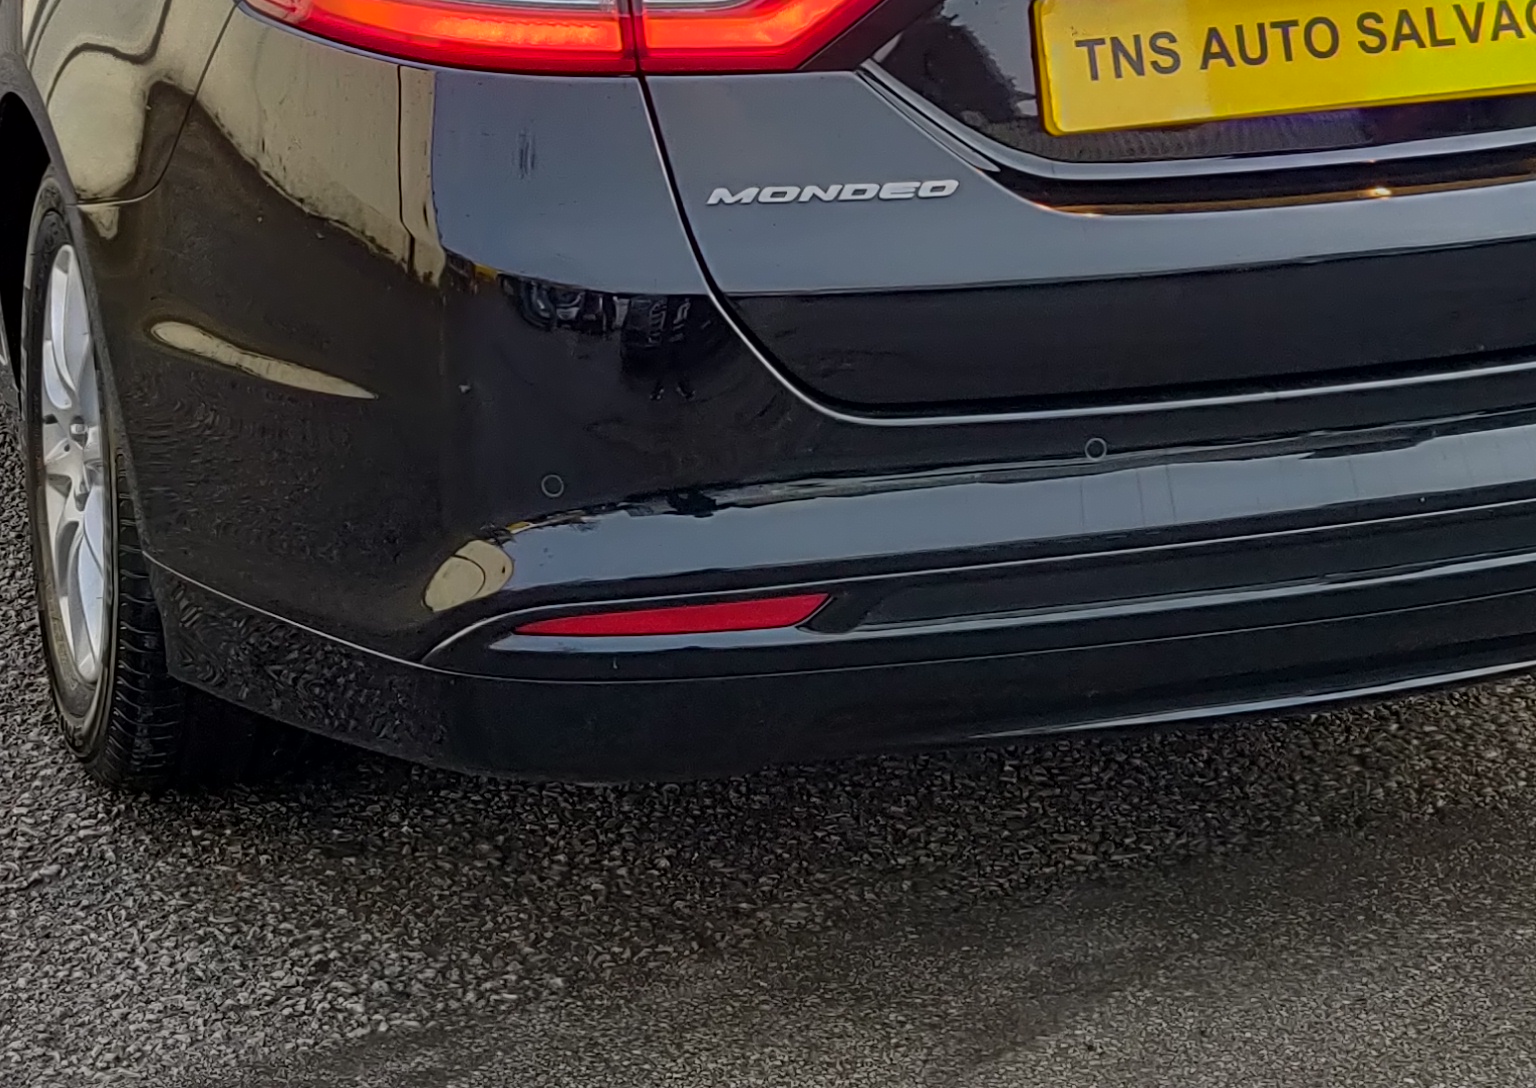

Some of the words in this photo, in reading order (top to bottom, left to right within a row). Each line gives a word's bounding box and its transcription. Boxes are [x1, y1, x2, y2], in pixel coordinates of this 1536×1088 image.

[1075, 32, 1181, 81] TNS
[1199, 16, 1340, 70] AUTO
[705, 178, 961, 206] MONDEO
